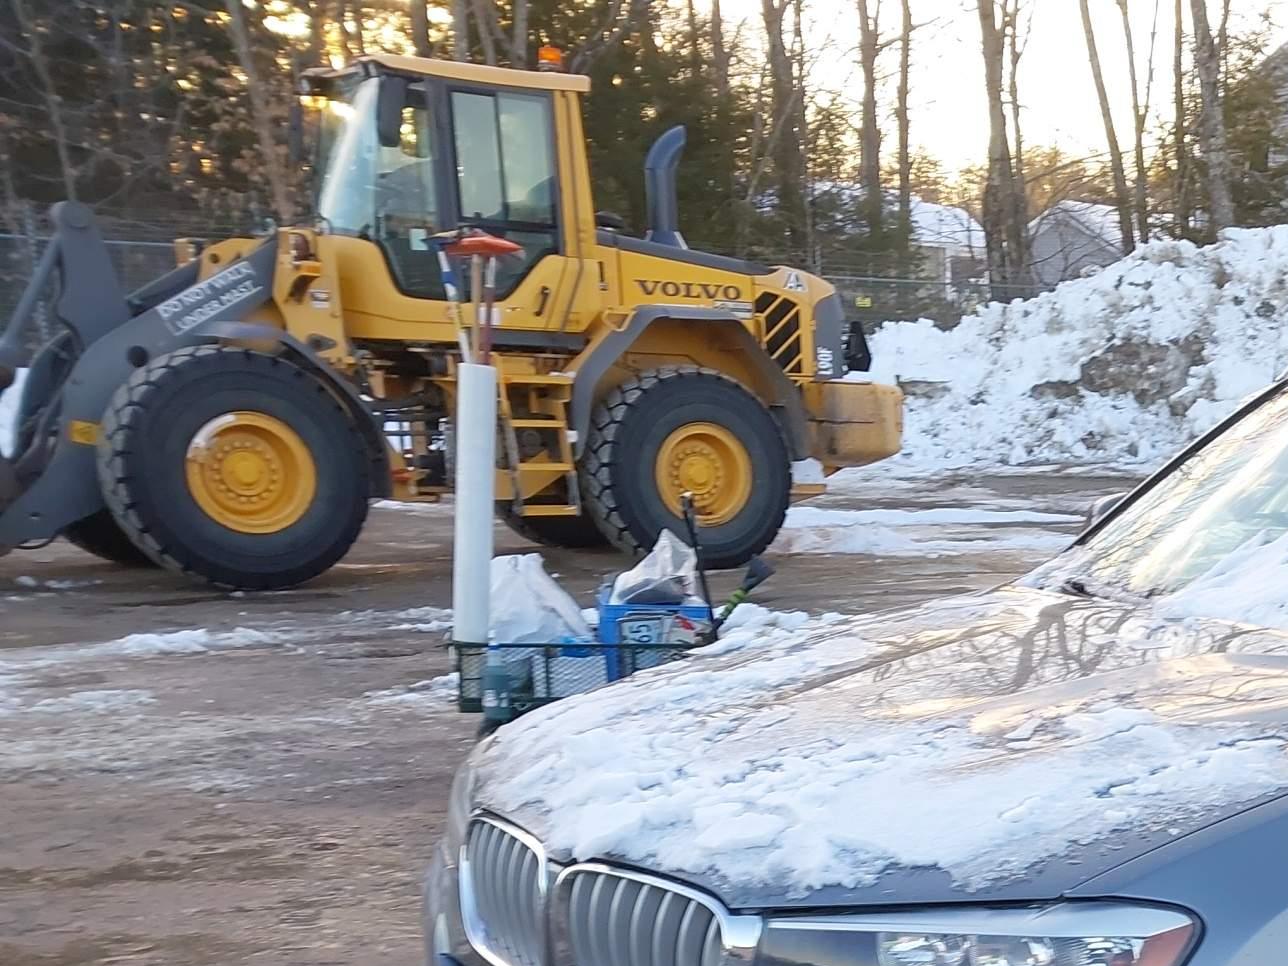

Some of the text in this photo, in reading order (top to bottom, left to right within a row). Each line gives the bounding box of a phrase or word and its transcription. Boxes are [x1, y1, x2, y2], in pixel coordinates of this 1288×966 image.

[635, 279, 741, 300] VOLVO
[157, 300, 183, 318] DO
[816, 346, 833, 375] L90F
